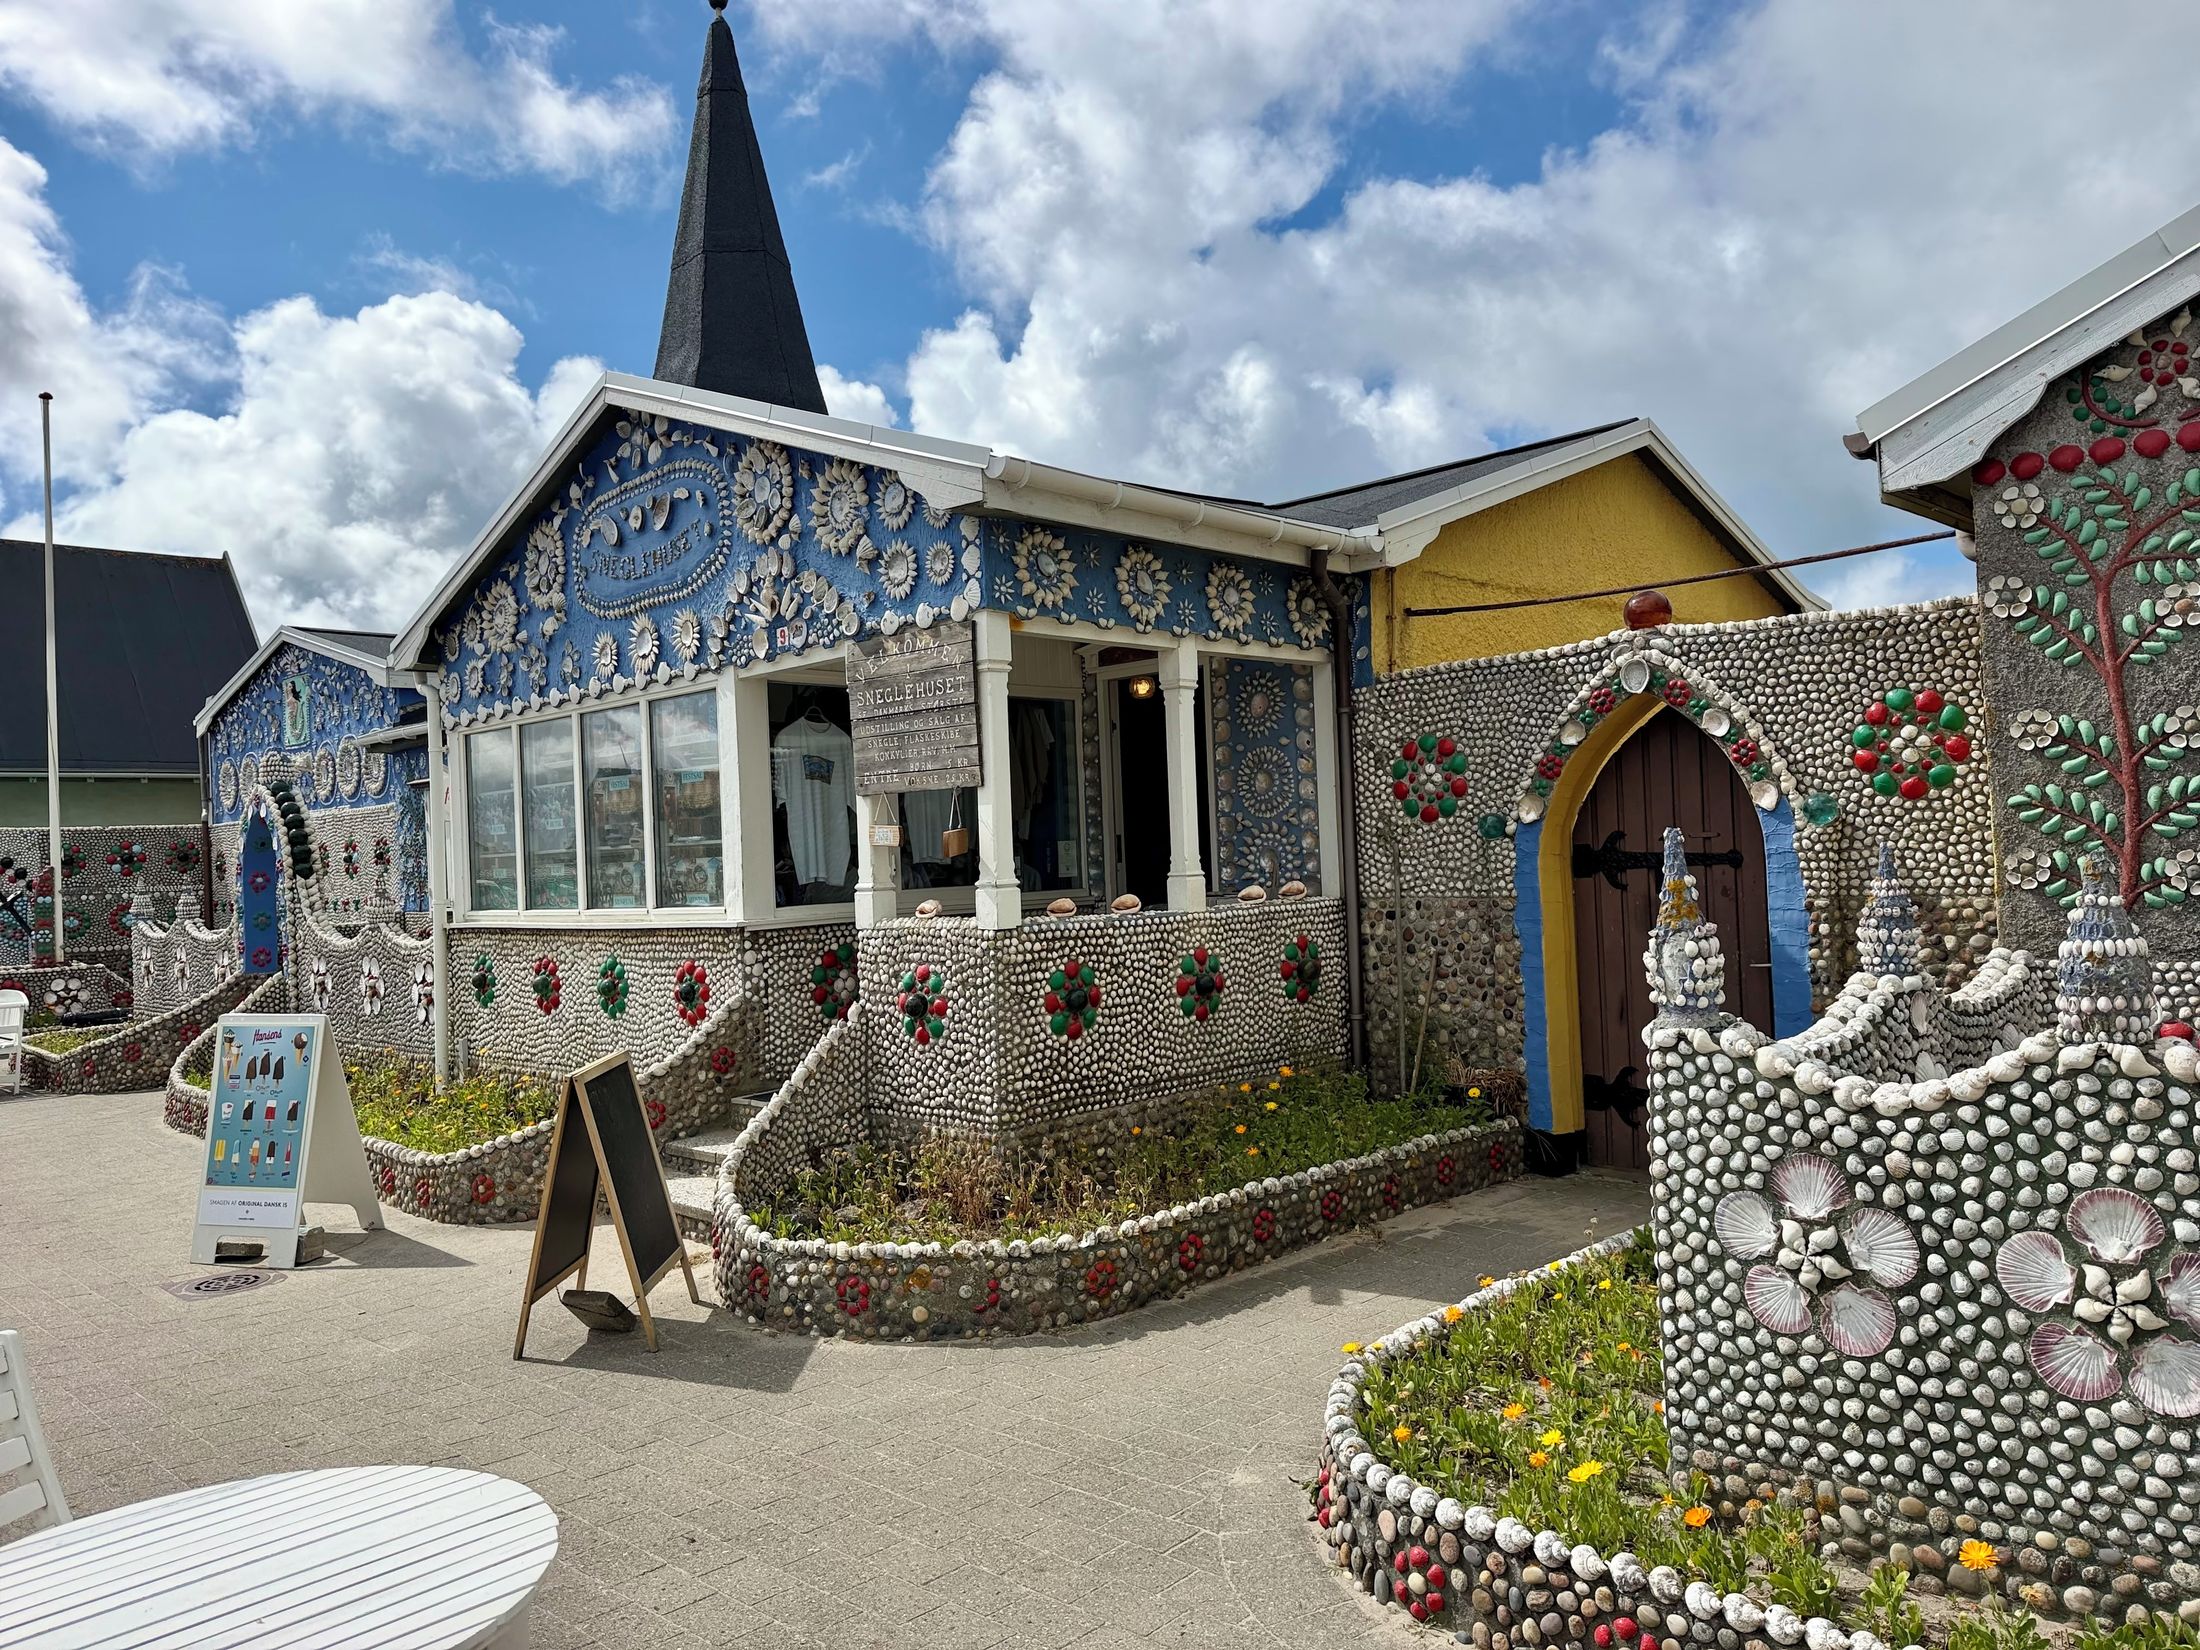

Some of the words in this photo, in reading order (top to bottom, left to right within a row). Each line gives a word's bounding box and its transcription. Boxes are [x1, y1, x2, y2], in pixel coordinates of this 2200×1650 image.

[589, 518, 701, 580] SNEGLEHUSET
[780, 629, 786, 645] 9
[856, 638, 964, 684] VELKOMMEN
[856, 676, 966, 707] SNEGLEHUSET
[859, 720, 909, 735] UDSTILLING
[913, 718, 924, 728] OG
[928, 715, 951, 726] SALG
[954, 713, 966, 723] AF
[947, 758, 952, 769] 5
